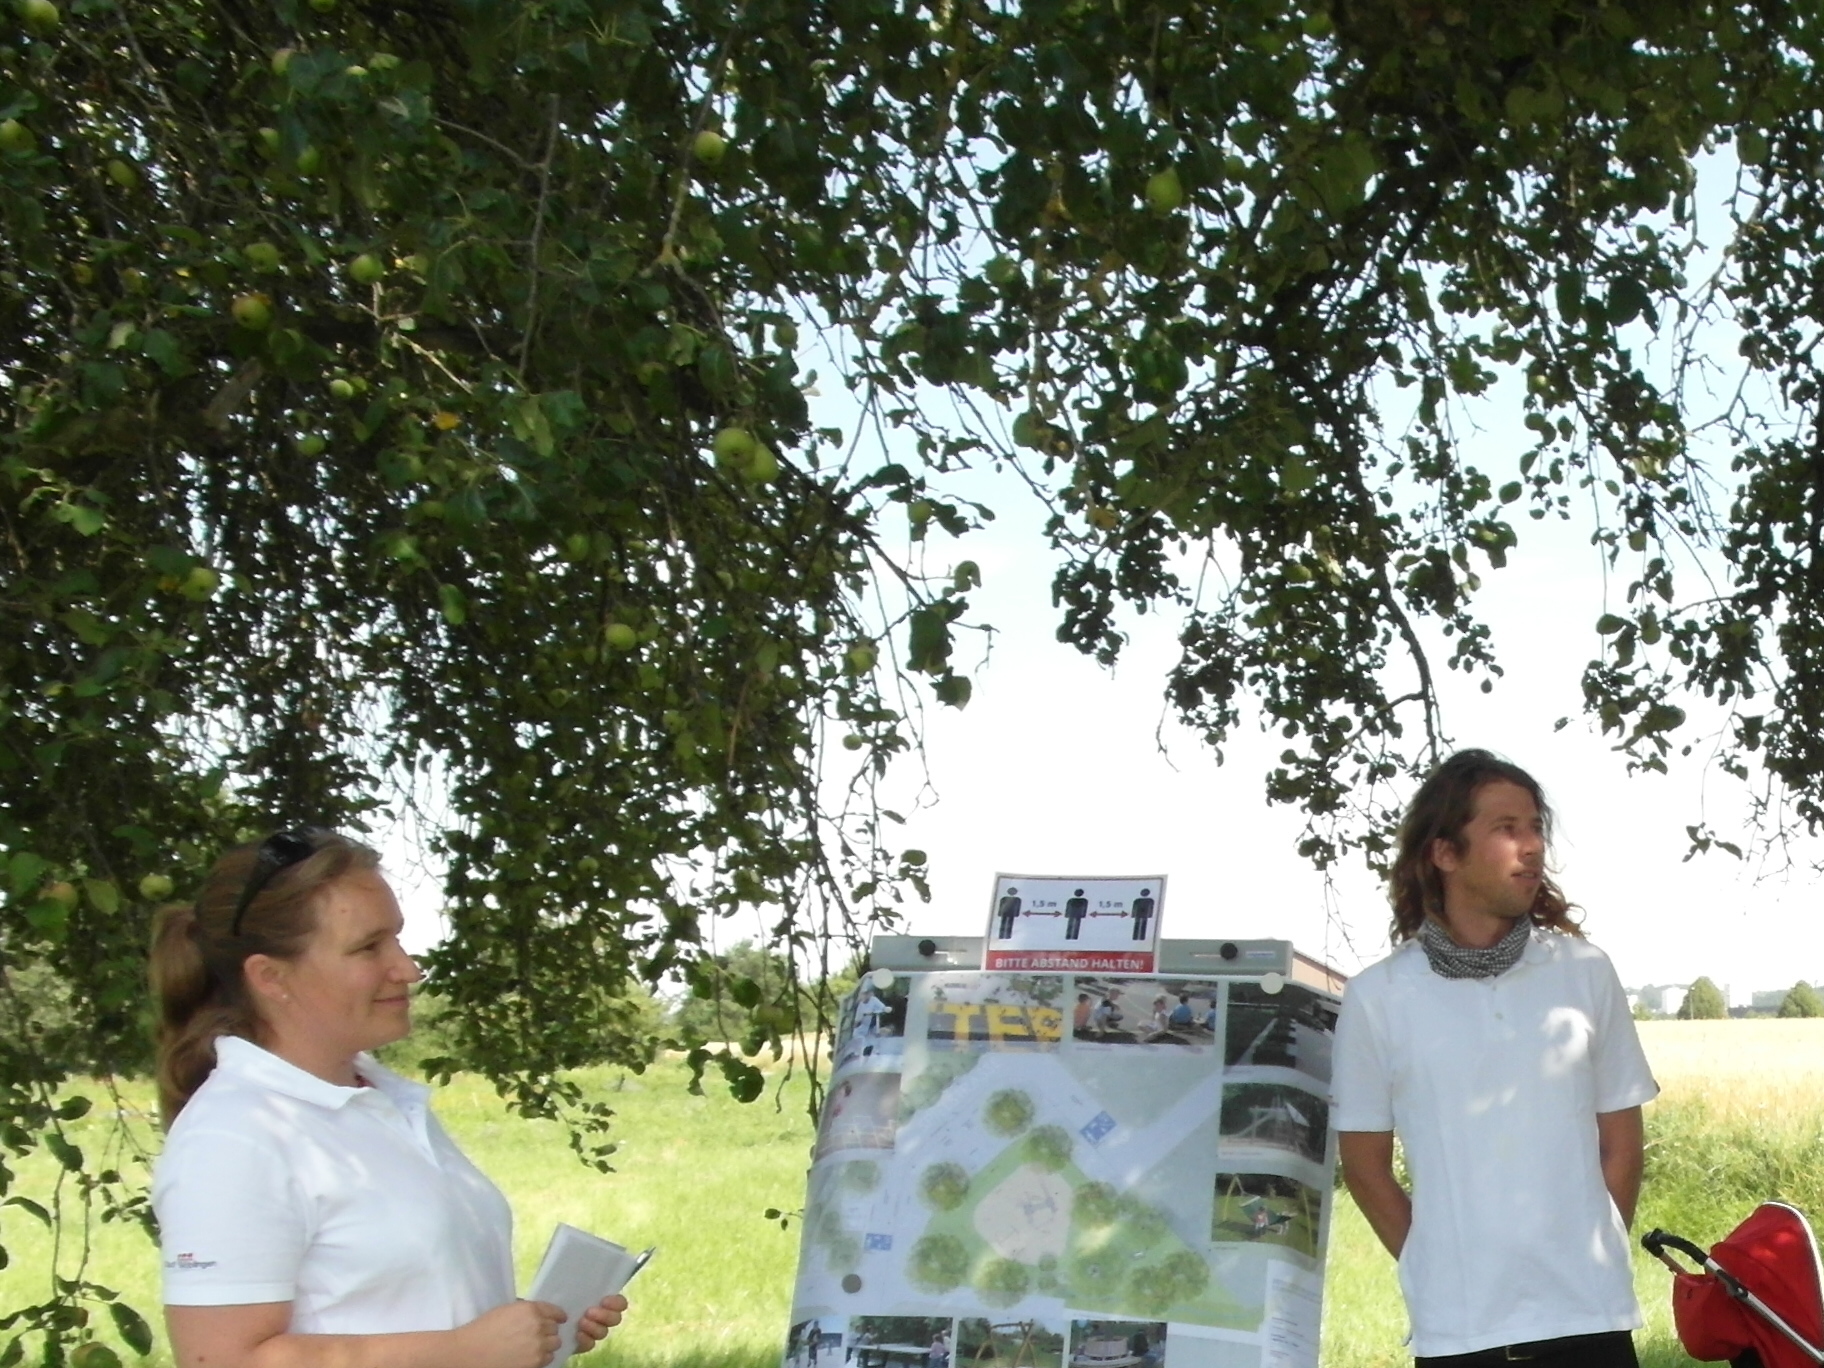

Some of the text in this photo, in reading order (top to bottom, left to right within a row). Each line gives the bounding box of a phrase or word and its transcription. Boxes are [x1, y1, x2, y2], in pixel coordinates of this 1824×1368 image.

[1031, 900, 1046, 908] 1,5
[1098, 900, 1112, 909] 1,5
[995, 957, 1145, 971] BITTE ABSTAND HALTEN!
